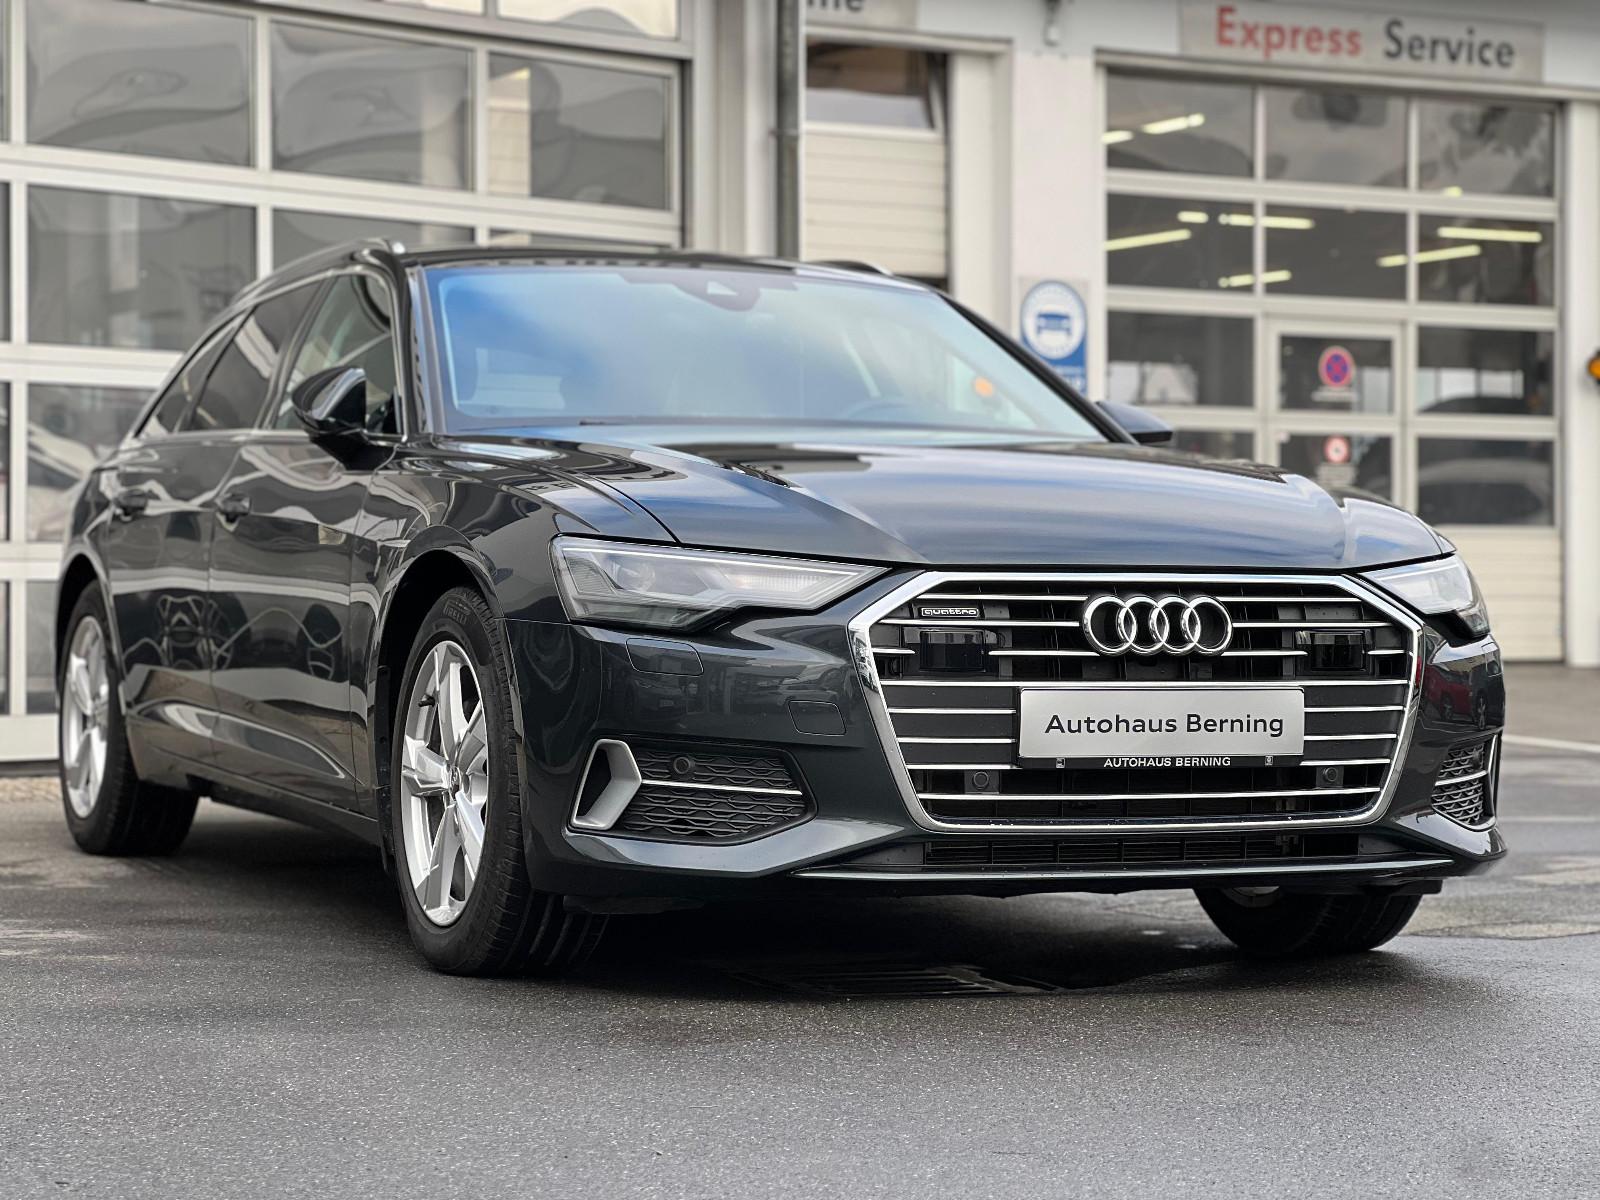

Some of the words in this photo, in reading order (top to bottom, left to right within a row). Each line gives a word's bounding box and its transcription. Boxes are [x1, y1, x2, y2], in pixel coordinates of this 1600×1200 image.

[1216, 5, 1363, 59] Express
[1384, 18, 1516, 68] Service
[1045, 714, 1178, 734] Autohaus
[1186, 714, 1284, 738] Berning
[1103, 757, 1172, 768] AUTOHAUS
[1175, 757, 1232, 768] BERNING
